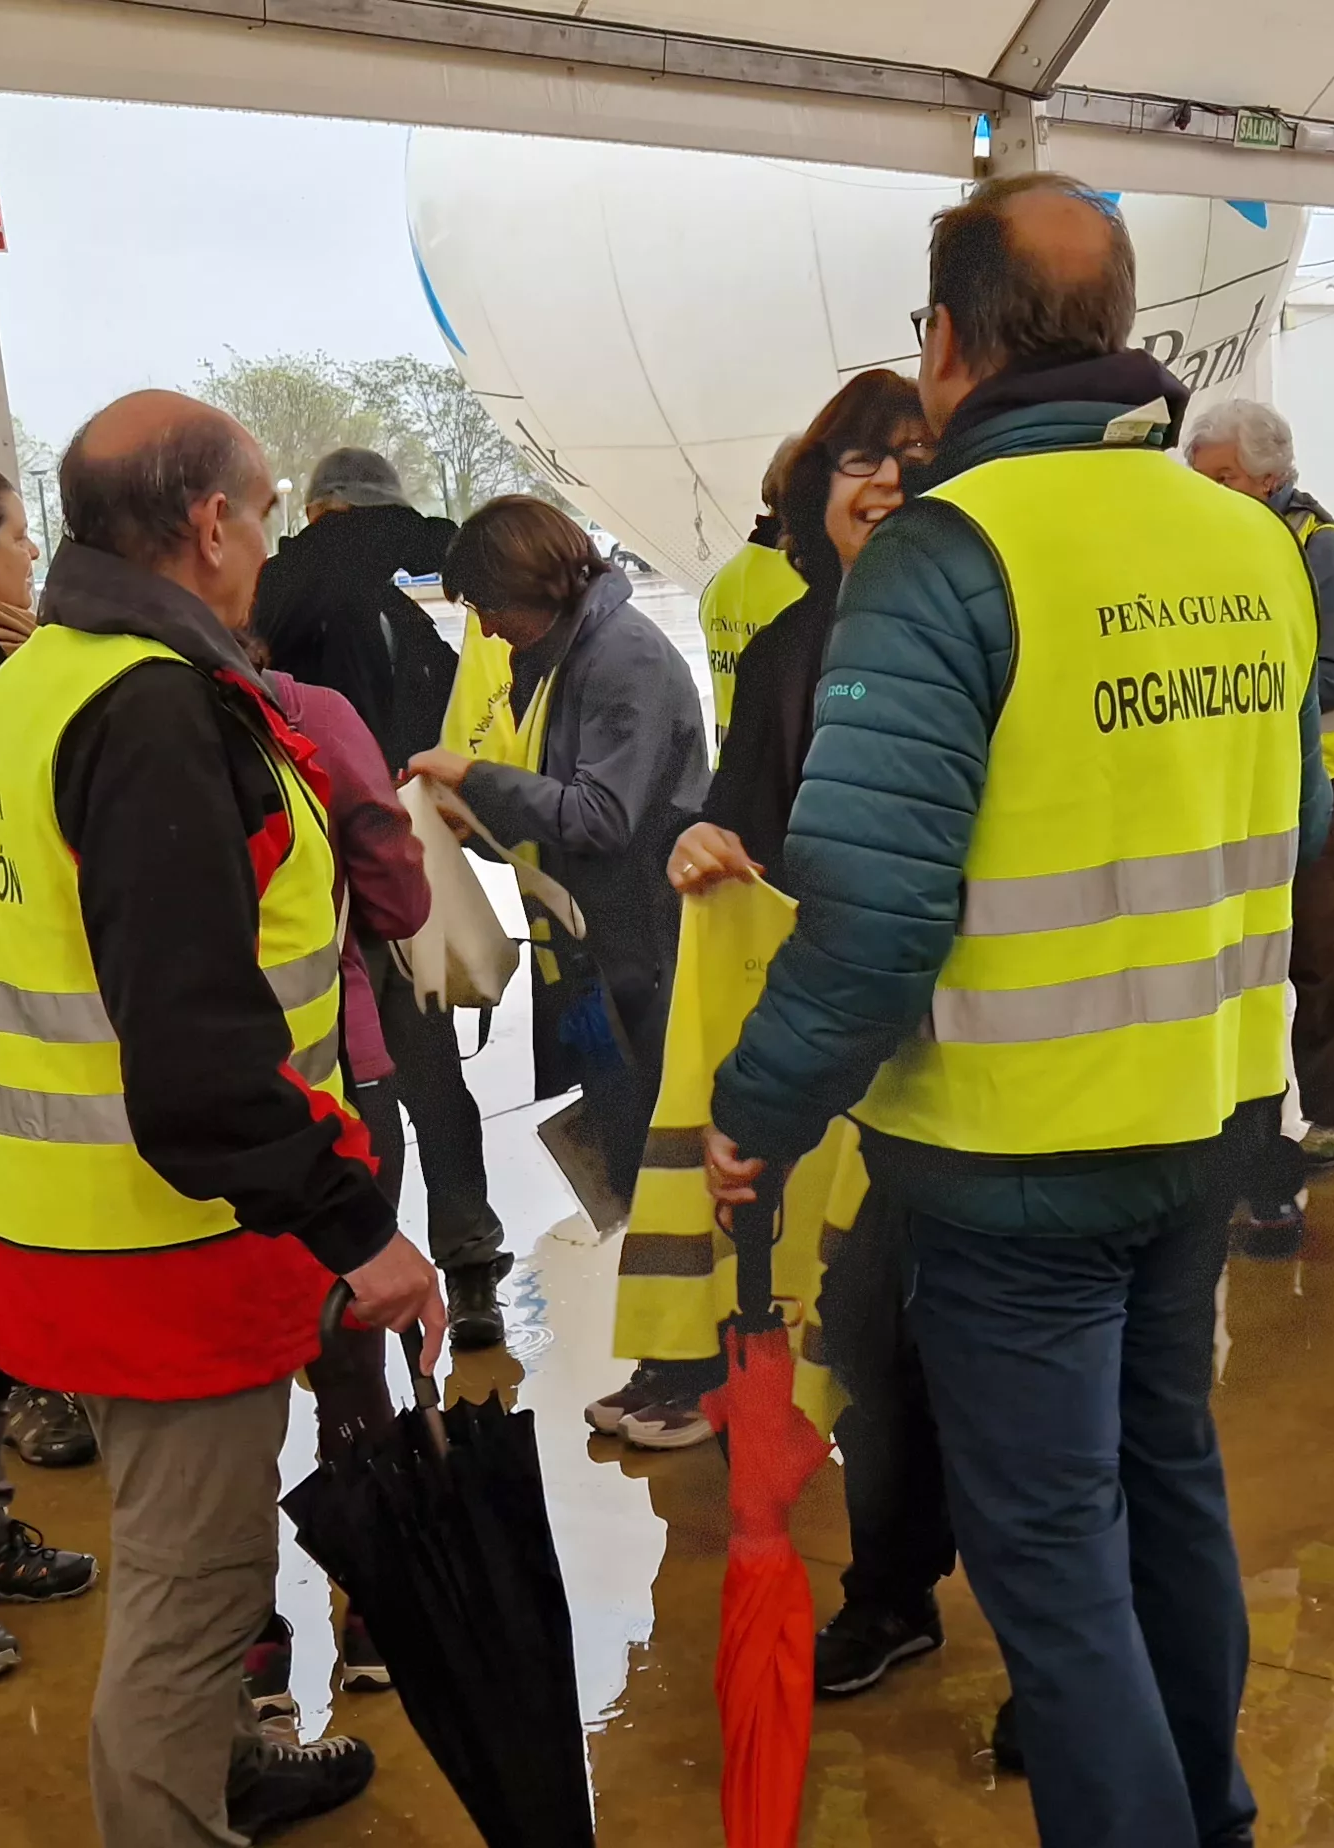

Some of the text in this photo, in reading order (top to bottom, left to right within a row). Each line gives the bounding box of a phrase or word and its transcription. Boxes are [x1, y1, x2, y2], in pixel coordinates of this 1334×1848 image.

[1239, 115, 1278, 142] SALIDA
[1096, 593, 1272, 637] PEÑA GUARA
[1094, 650, 1285, 734] ORGANIZACIÓN
